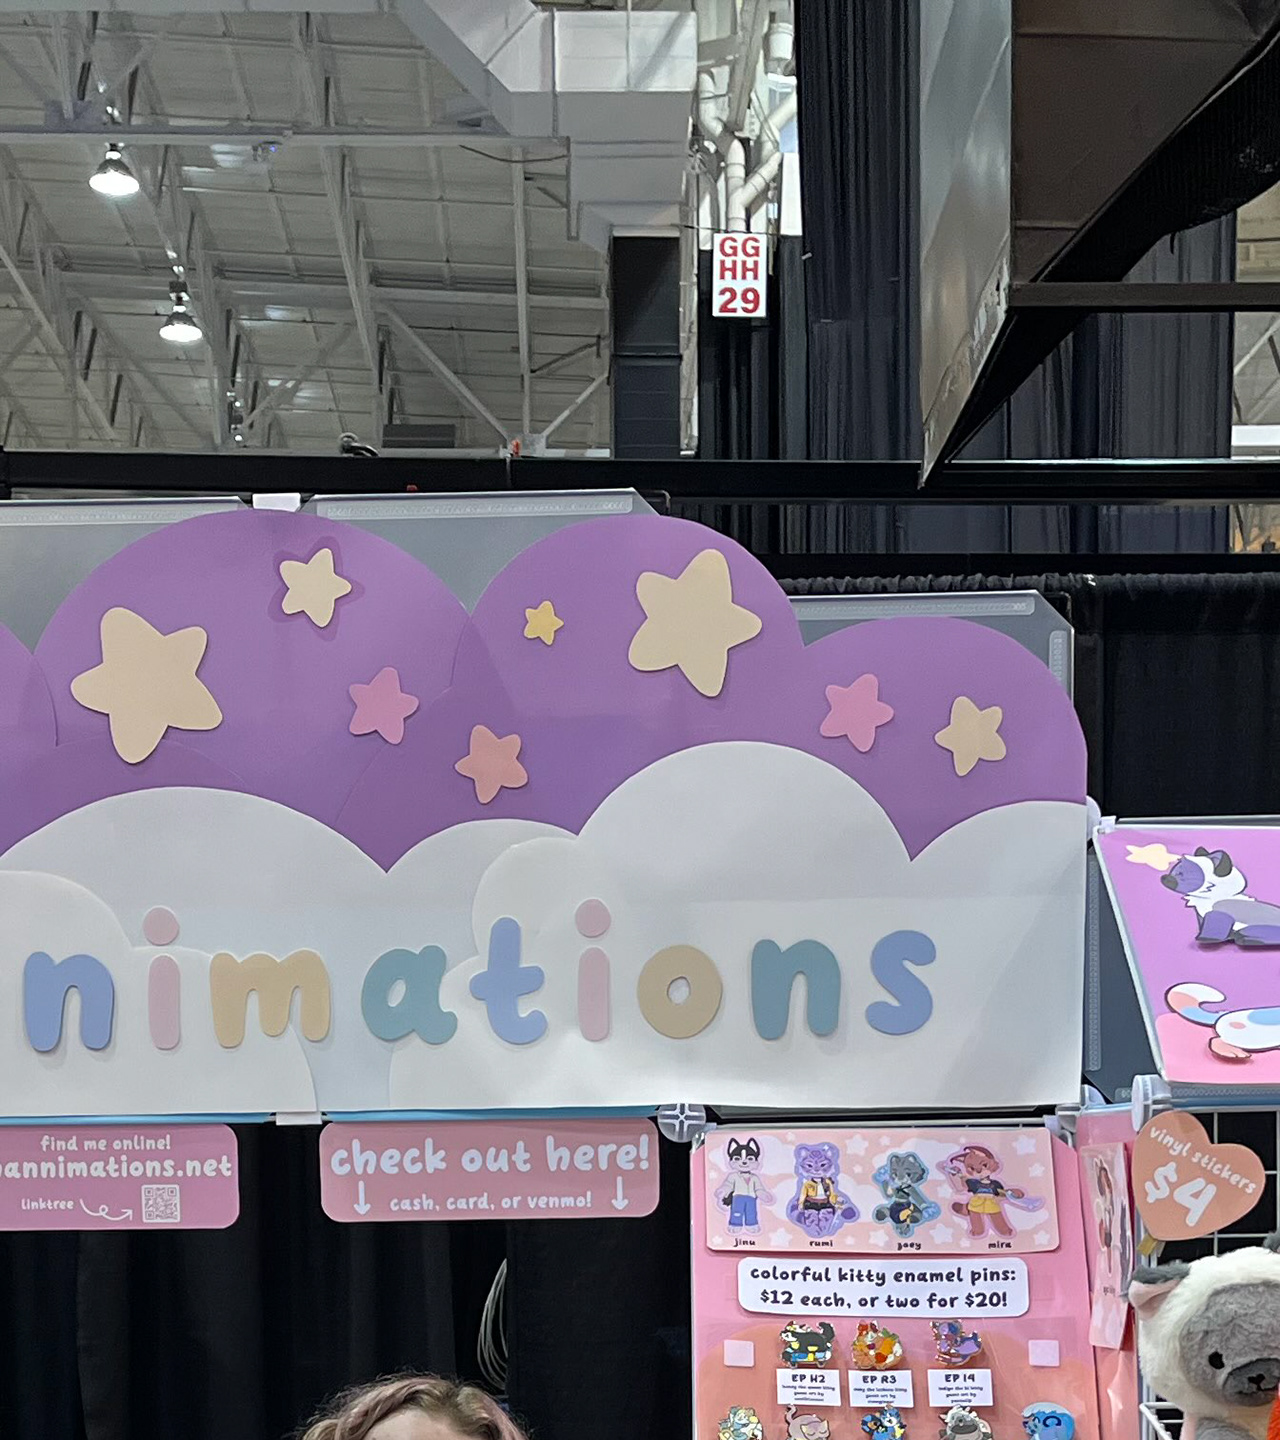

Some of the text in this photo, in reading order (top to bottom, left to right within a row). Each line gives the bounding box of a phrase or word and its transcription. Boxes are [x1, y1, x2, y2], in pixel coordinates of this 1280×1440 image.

[720, 237, 760, 257] GG
[720, 260, 759, 280] HH
[719, 287, 760, 314] 29
[40, 1133, 171, 1152] find me online!
[330, 1133, 650, 1176] check out here!
[1150, 1126, 1257, 1194] vinyl stickers
[21, 1197, 74, 1210] linktree
[389, 1190, 592, 1212] cash, card, or venmo!
[1144, 1161, 1217, 1227] $4
[733, 1237, 756, 1248] jinu
[988, 1240, 1012, 1249] mira
[750, 1265, 1016, 1287] colorful kitty enamel pins:
[760, 1288, 1008, 1309] $12 each, or two for $20!
[791, 1373, 826, 1384] EP H2
[862, 1374, 897, 1384] EP R3
